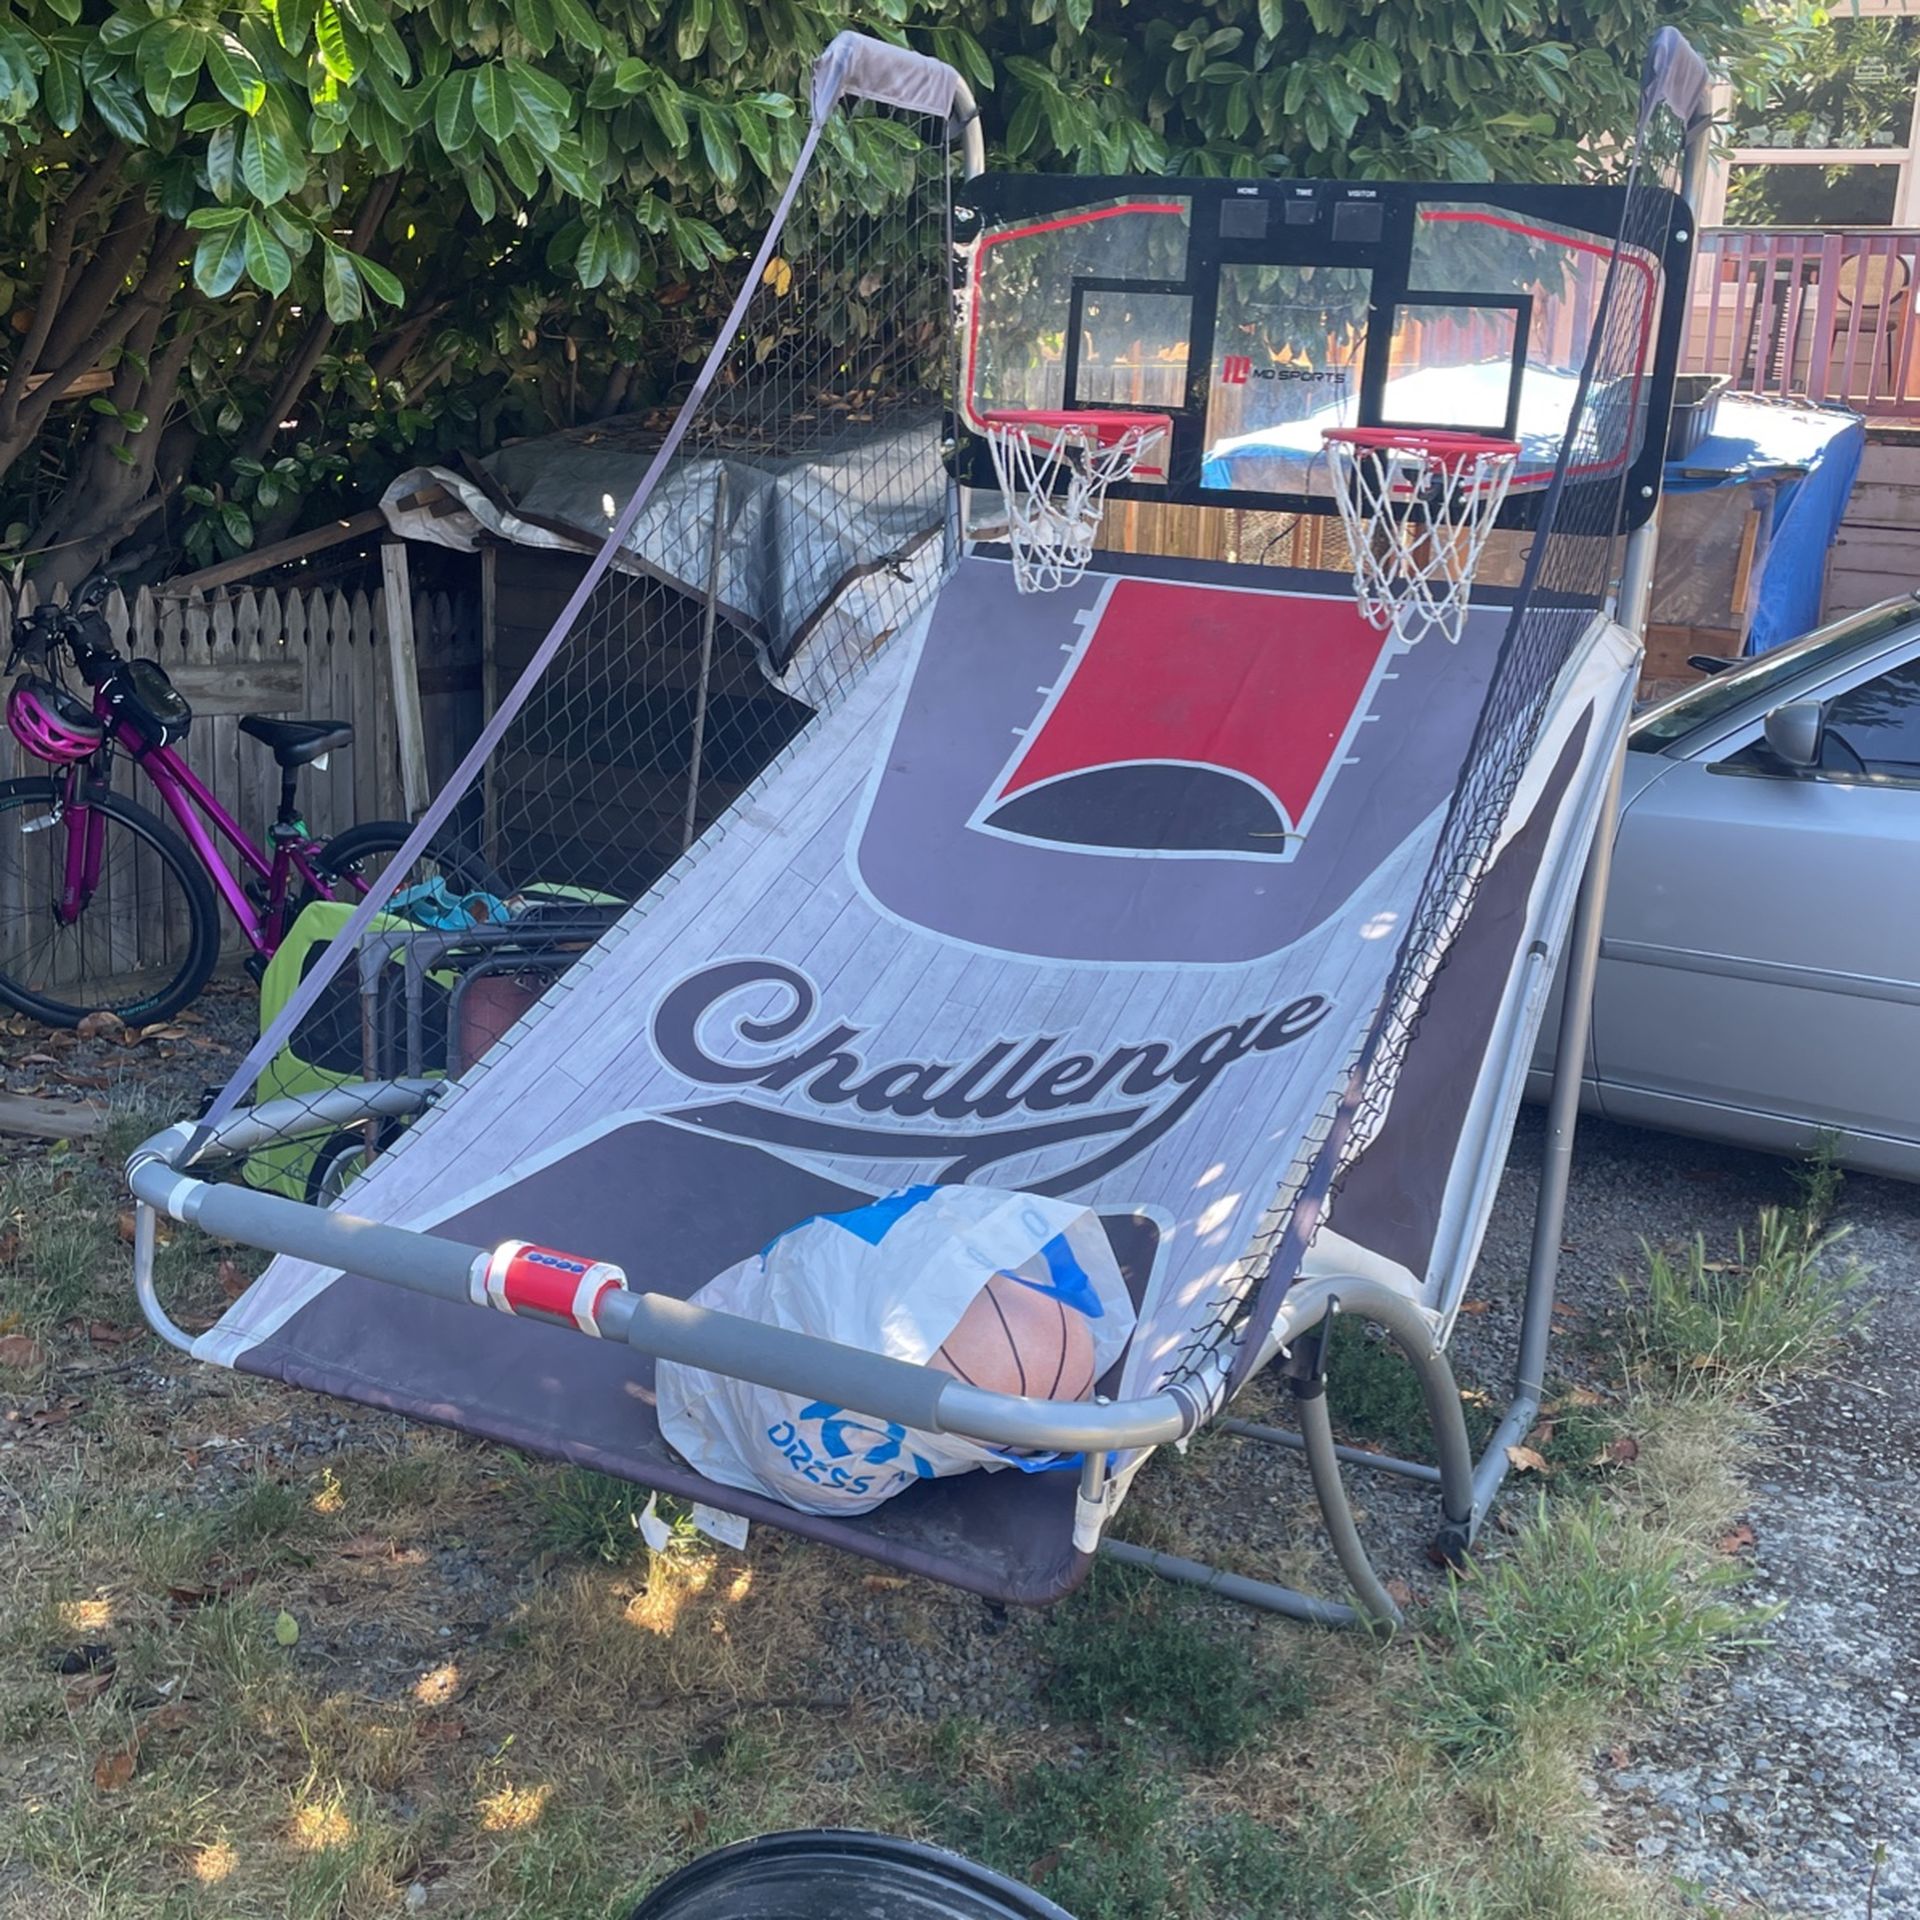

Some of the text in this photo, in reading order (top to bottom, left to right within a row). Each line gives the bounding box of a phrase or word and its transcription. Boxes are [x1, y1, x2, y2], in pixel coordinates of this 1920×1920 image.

[1237, 187, 1259, 196] HOME
[1296, 188, 1313, 197] TIME
[1347, 190, 1377, 198] VISITOR
[1278, 370, 1346, 384] SPORTS
[650, 957, 1335, 1145] Challenge
[767, 1420, 876, 1495] DRESS
